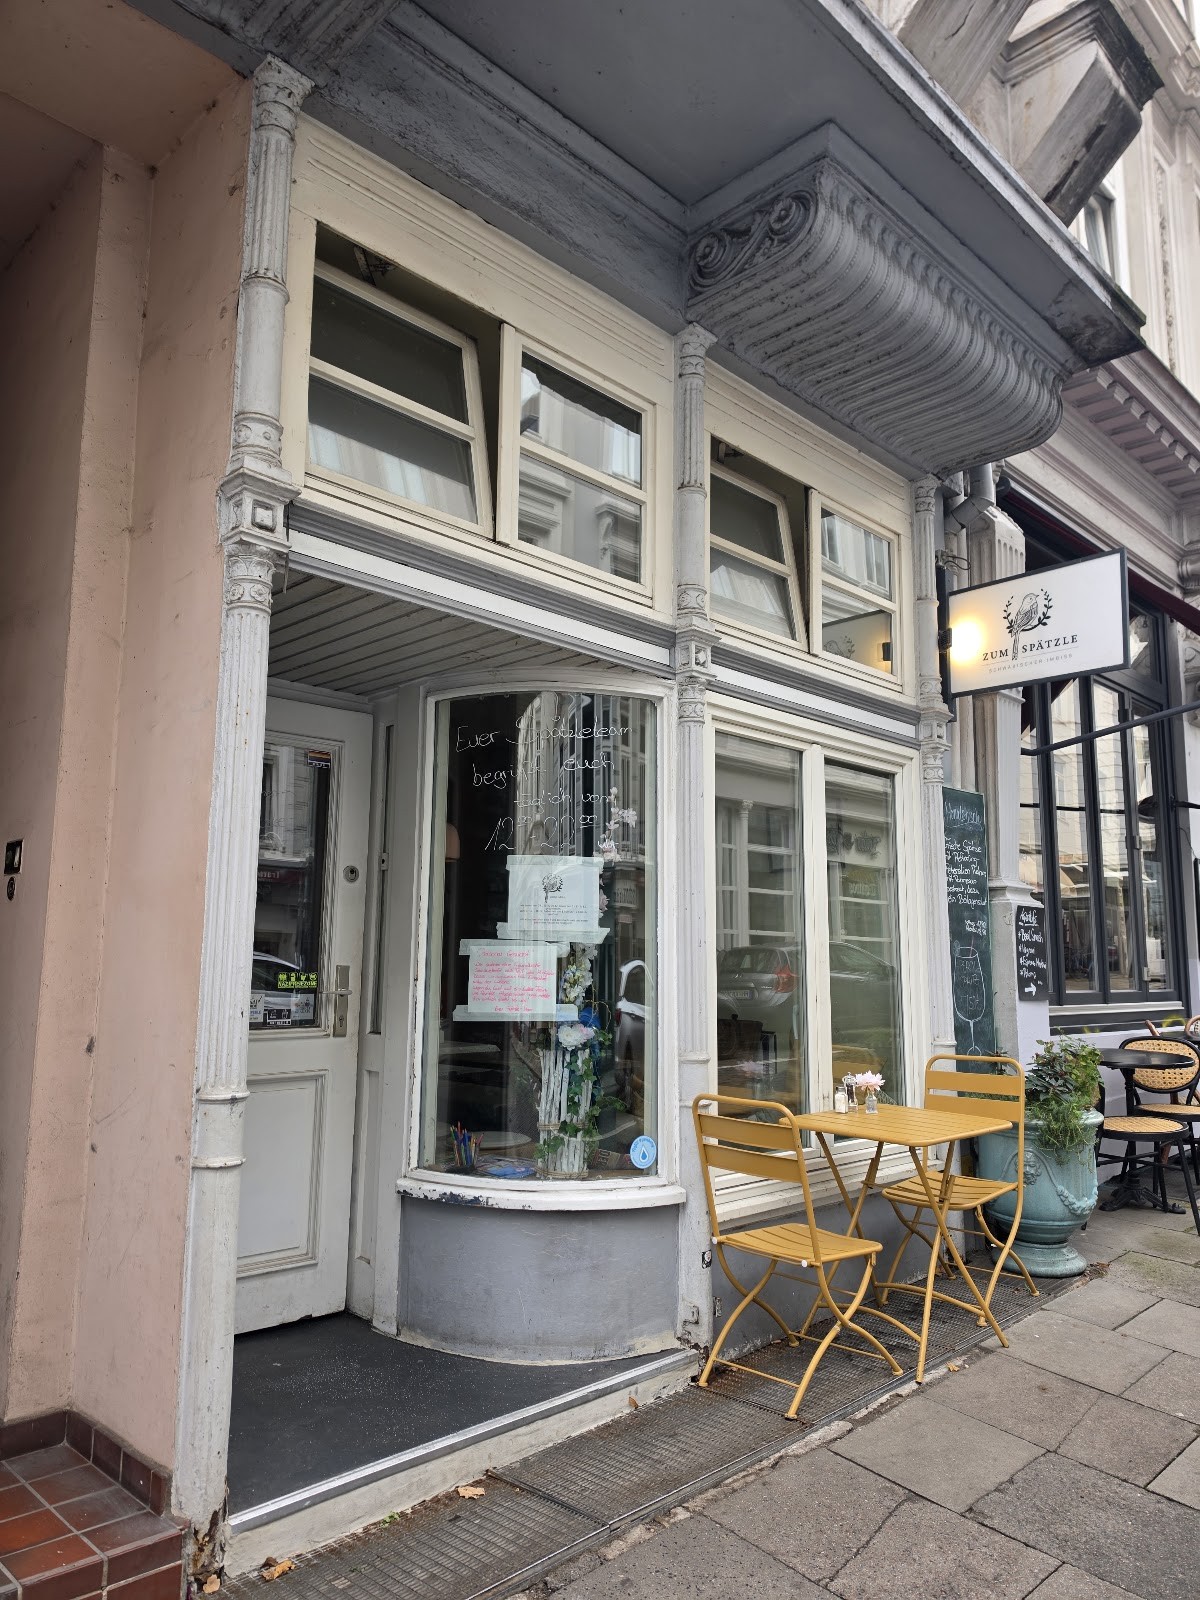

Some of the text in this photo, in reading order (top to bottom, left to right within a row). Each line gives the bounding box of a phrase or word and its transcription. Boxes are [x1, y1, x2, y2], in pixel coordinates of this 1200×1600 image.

[982, 634, 1079, 661] ZUM SPÄTZLE
[456, 726, 501, 752] Euer
[563, 751, 615, 771] euch
[581, 793, 609, 803] von
